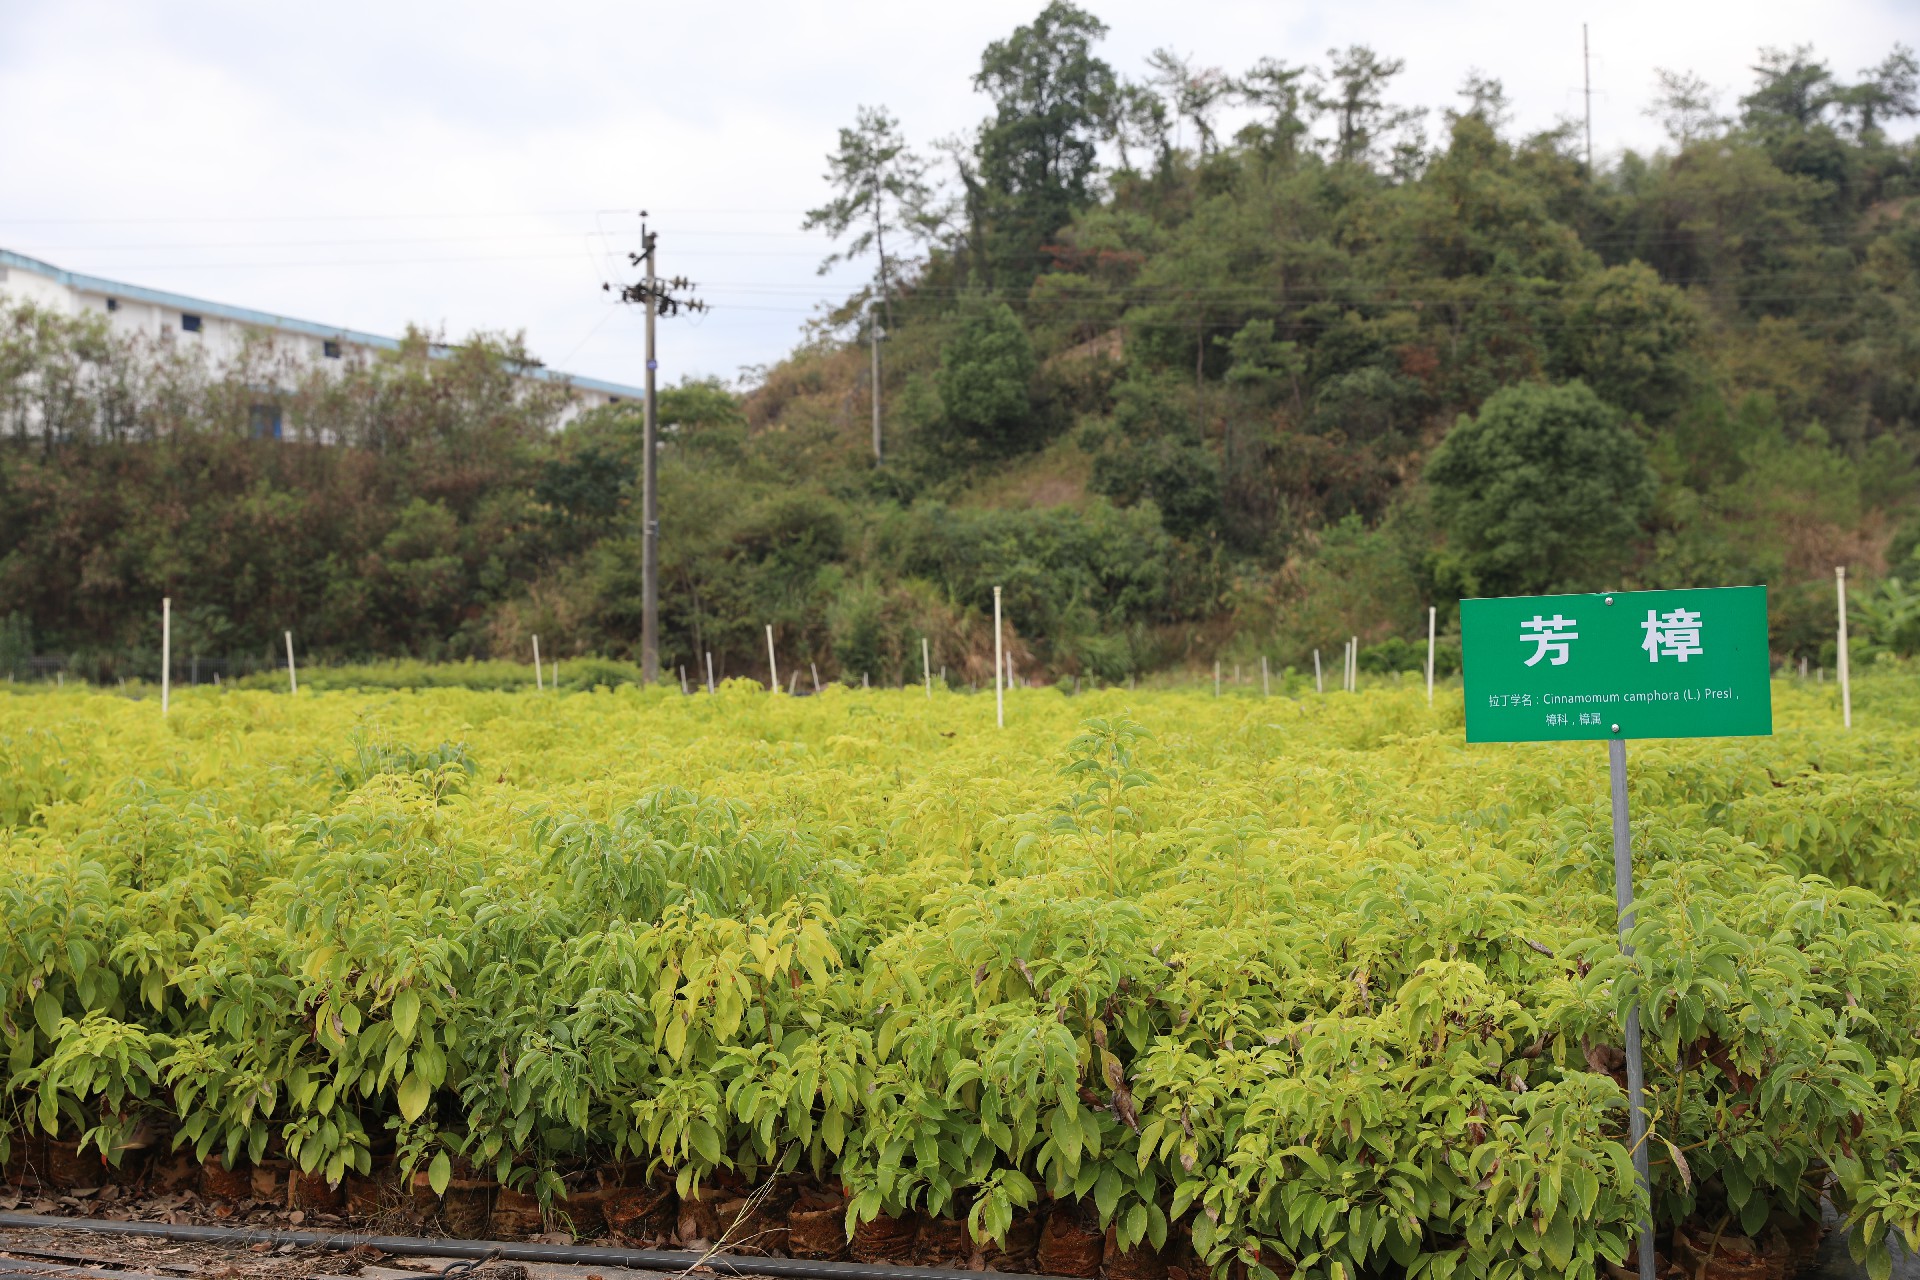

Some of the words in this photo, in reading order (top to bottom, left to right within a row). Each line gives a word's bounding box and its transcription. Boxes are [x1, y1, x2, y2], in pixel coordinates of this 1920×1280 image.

[1543, 693, 1620, 705] Cinnamomum
[1623, 689, 1680, 704] camphora
[1683, 688, 1701, 702] (L.)
